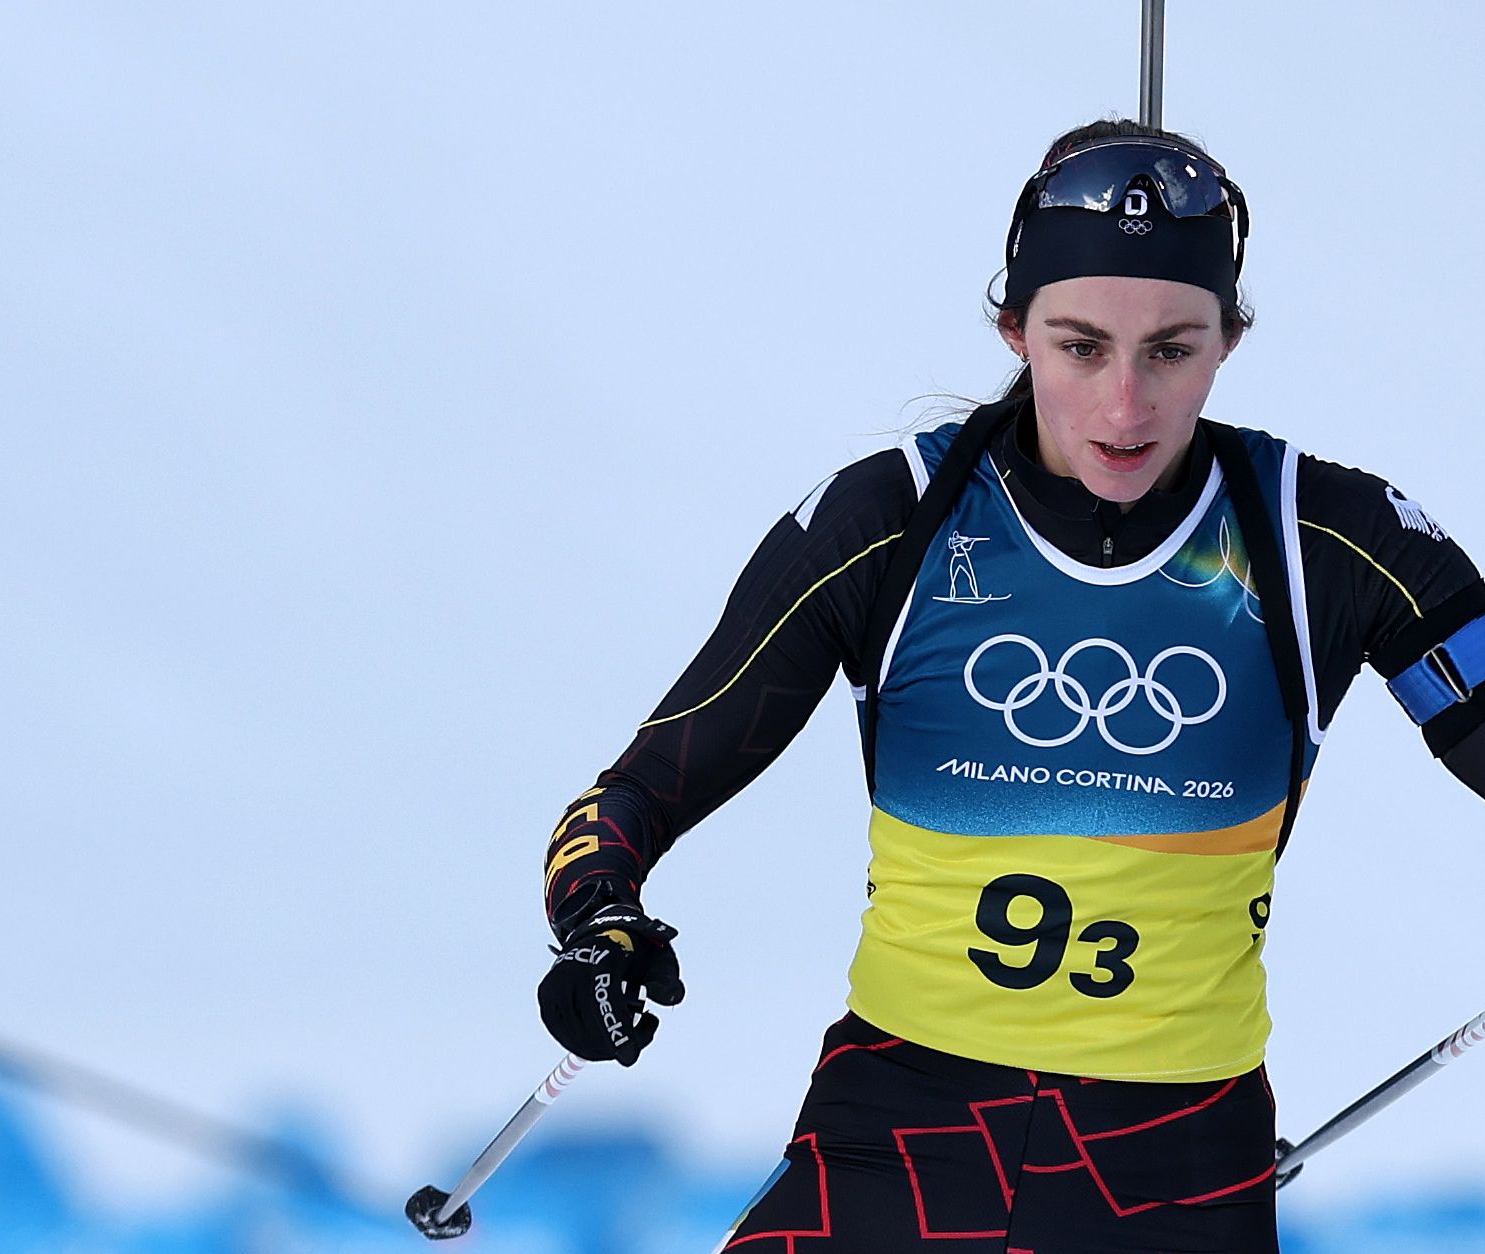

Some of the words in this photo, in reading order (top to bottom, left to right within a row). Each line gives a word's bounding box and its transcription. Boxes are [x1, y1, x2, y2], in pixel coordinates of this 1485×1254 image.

[936, 758, 1051, 784] MILANO
[1056, 769, 1176, 796] CORTINA
[1182, 780, 1234, 798] 2026
